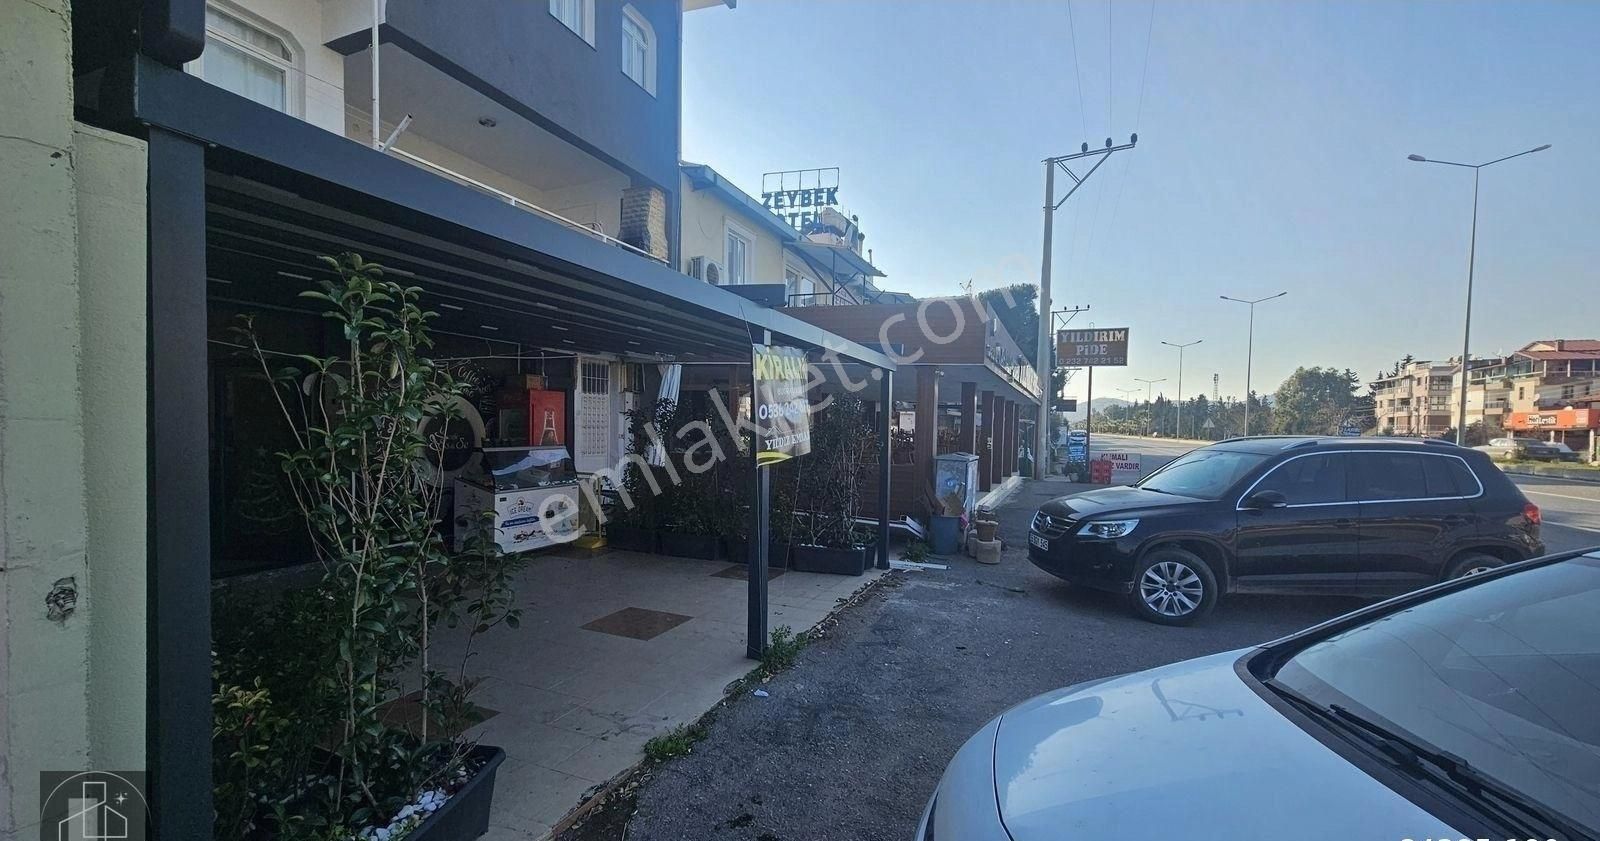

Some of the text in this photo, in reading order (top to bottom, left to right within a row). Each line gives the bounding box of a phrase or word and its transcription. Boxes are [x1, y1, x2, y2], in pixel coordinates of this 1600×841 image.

[762, 187, 839, 209] ZEYBEK
[1061, 330, 1126, 343] YILDIRIM
[1116, 462, 1140, 470] VARDIR
